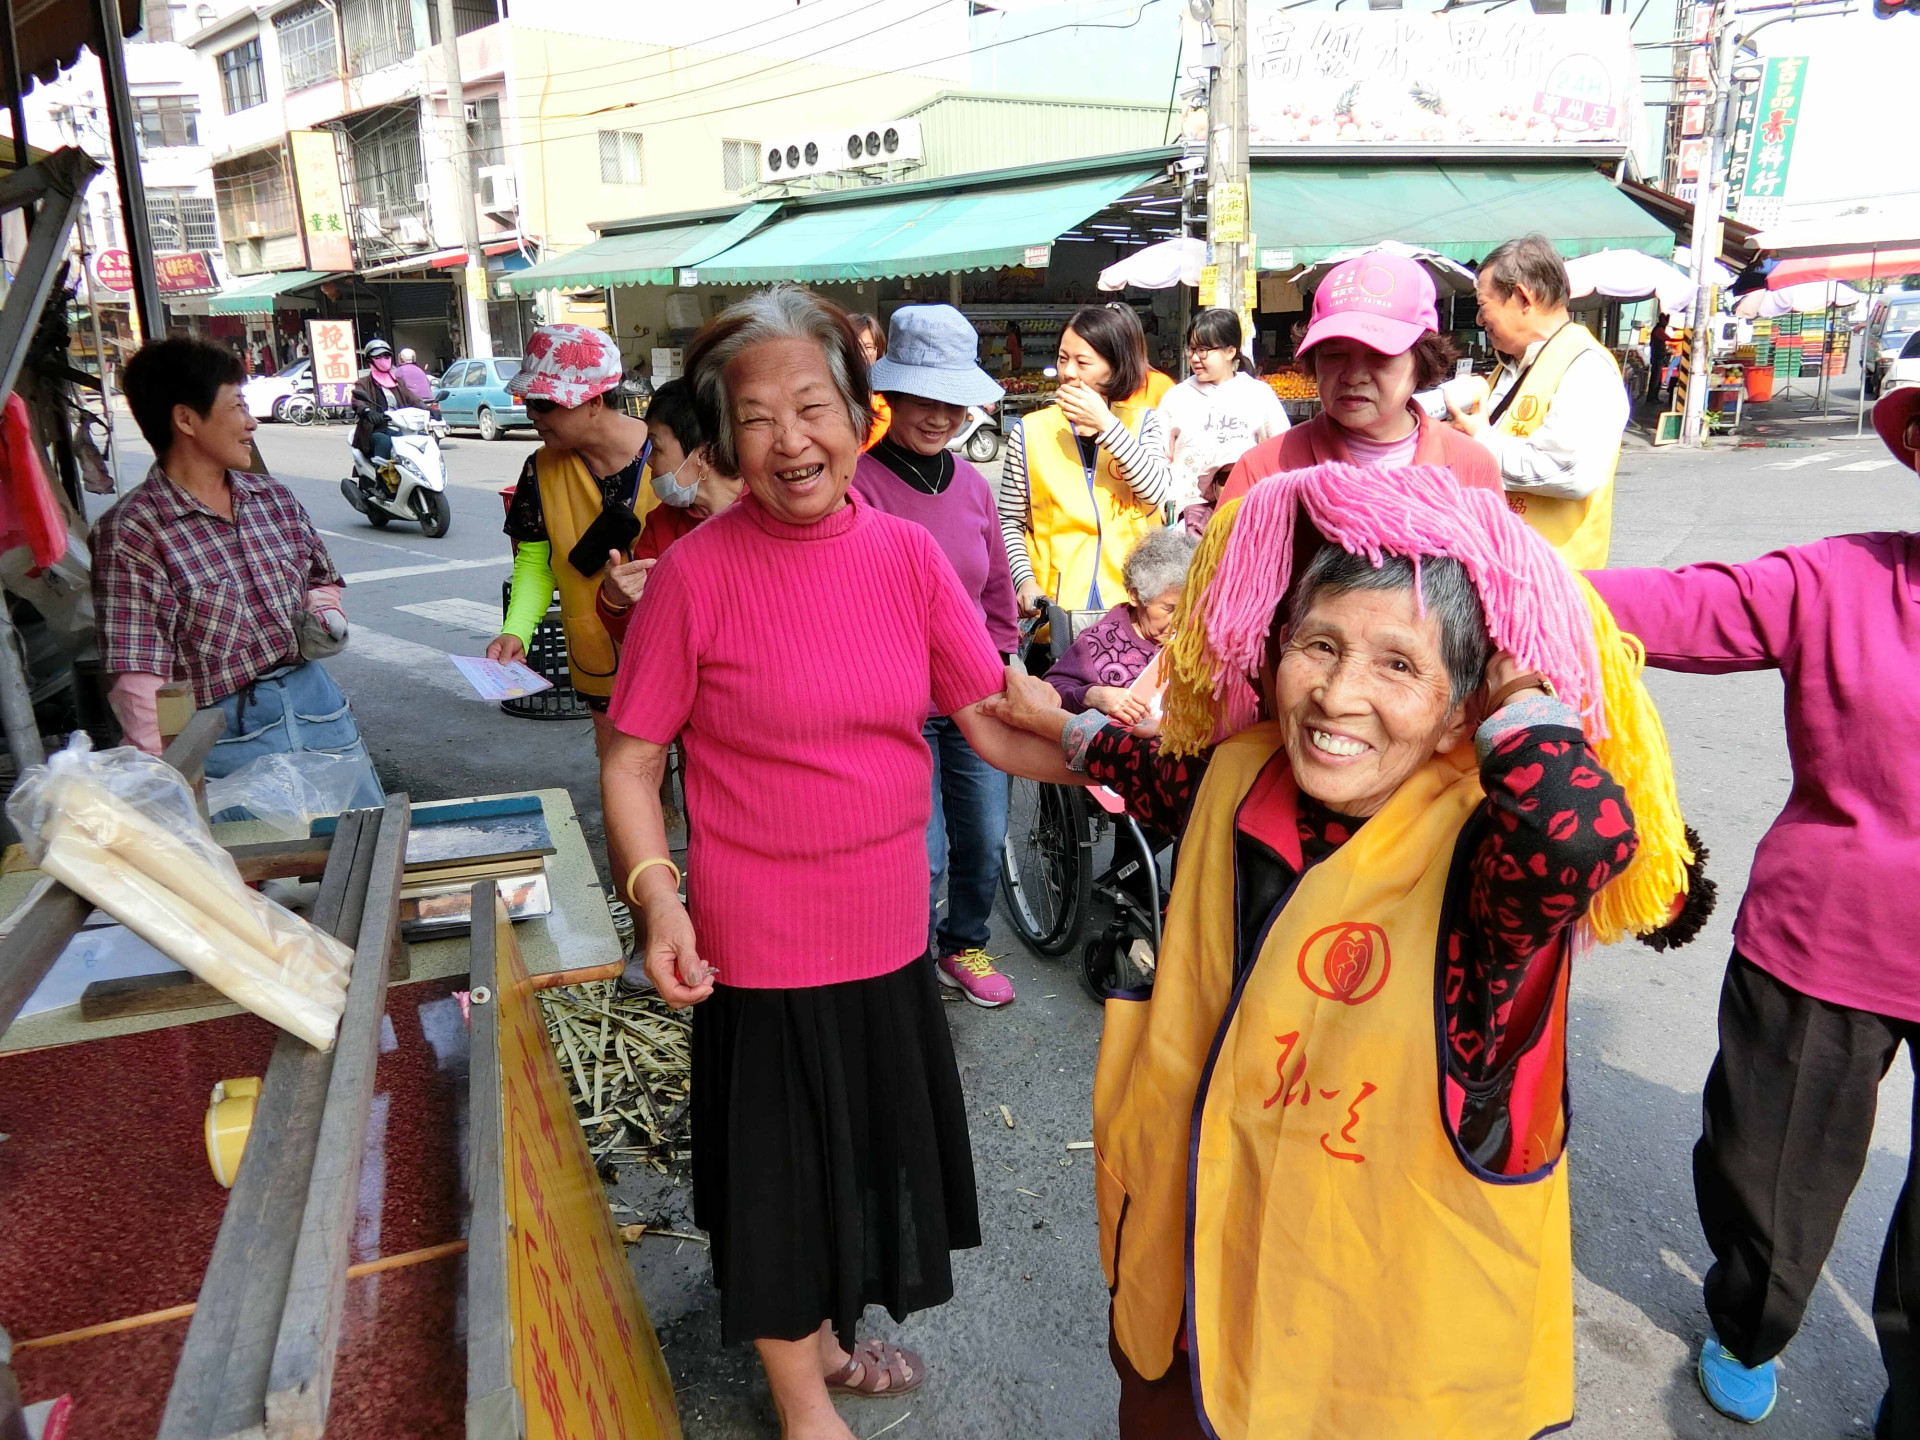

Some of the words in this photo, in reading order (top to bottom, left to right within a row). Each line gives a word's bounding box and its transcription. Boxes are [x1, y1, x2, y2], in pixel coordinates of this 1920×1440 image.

[1252, 15, 1553, 82] 高級水果行
[1556, 70, 1603, 96] 24H
[1540, 93, 1610, 127] 潮州店
[1751, 56, 1803, 196] 吉品素料行
[308, 212, 343, 231] 童裝
[318, 324, 350, 379] 挽面
